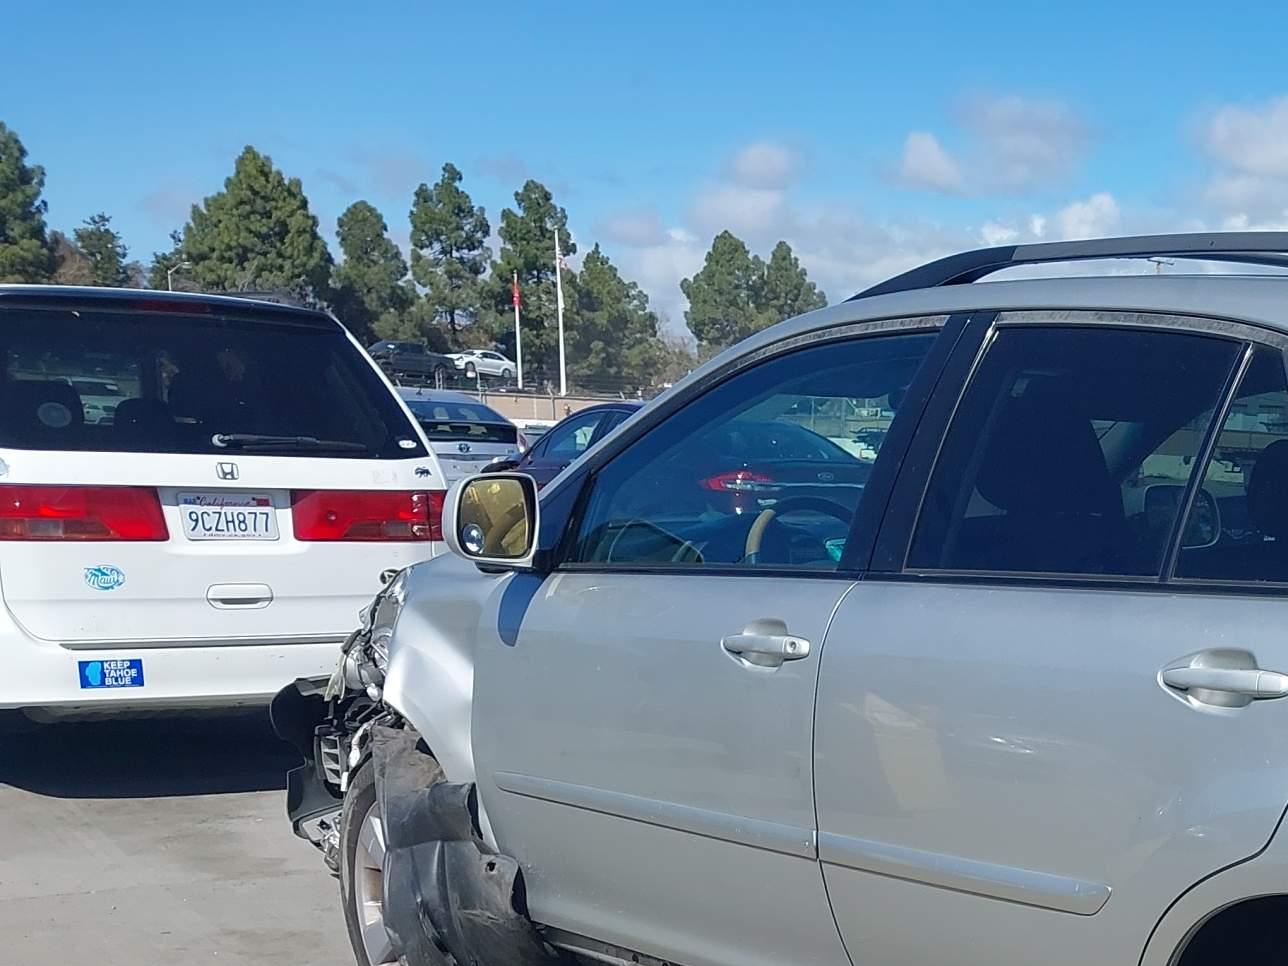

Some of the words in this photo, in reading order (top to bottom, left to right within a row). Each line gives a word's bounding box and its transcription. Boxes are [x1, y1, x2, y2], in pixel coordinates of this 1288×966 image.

[200, 496, 251, 509] California
[188, 511, 269, 532] 9CZH877
[104, 661, 130, 670] KEEP
[104, 669, 138, 677] TAHOE
[105, 677, 132, 686] BLUE
